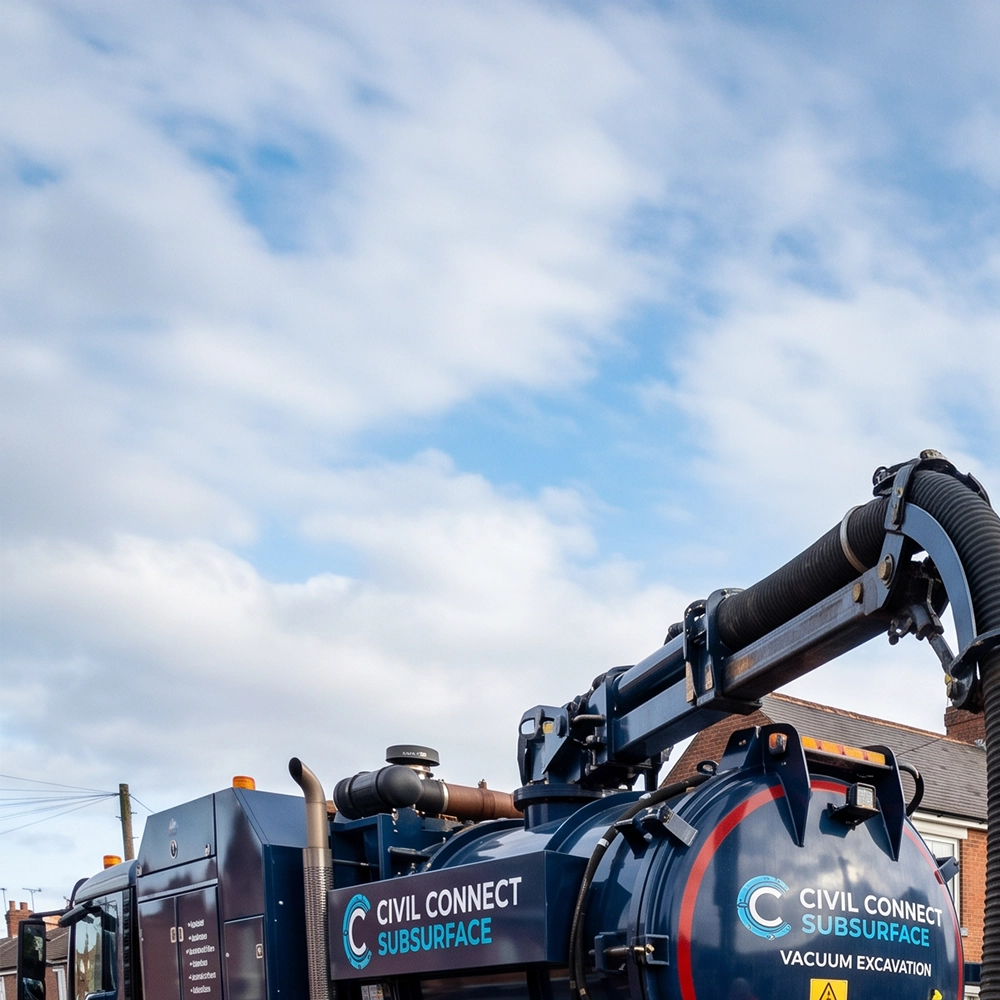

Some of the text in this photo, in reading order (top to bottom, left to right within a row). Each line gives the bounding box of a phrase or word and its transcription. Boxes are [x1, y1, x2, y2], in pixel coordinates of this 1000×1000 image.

[376, 876, 522, 926] CIVIL CONNECT
[800, 888, 943, 927] CIVIL CONNECT
[377, 917, 492, 956] SUBSURFACE
[801, 913, 930, 947] SUBSURFACE
[780, 950, 932, 977] VACUUM EXCAVATION
